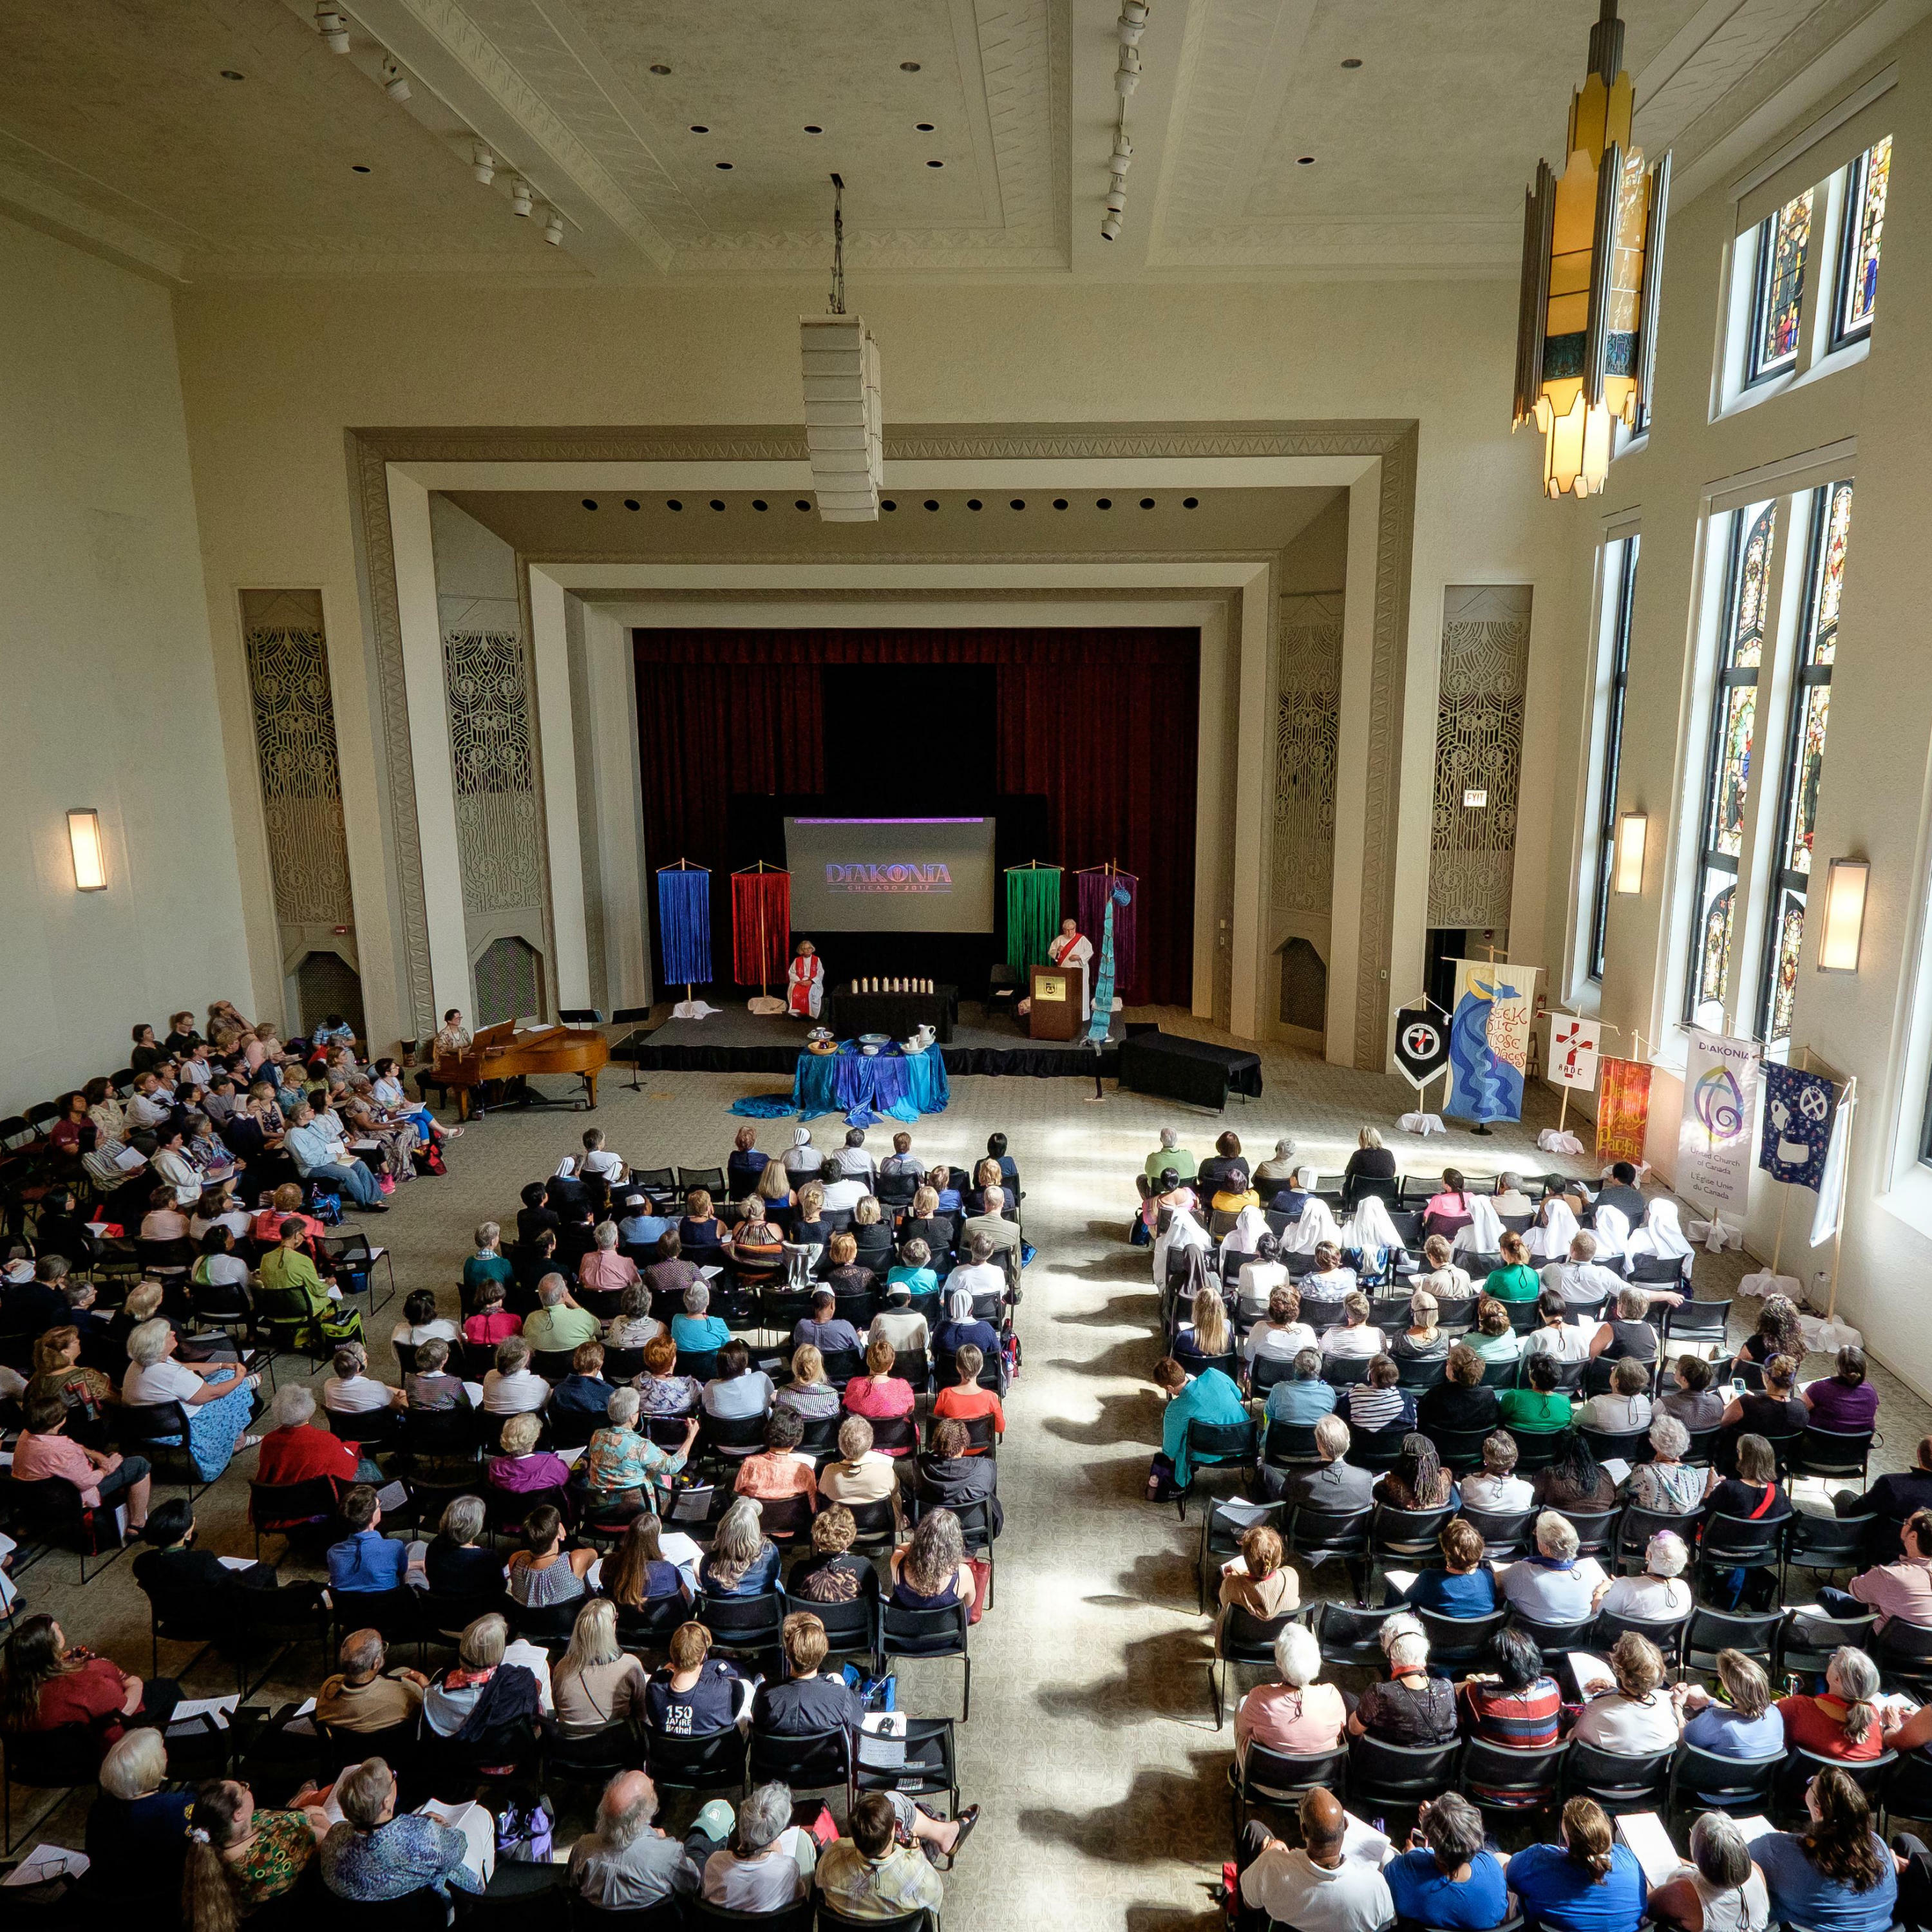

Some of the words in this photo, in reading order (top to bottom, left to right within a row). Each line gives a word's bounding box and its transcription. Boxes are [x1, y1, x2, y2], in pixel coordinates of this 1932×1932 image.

[1699, 1041, 1749, 1060] DIAKONIA
[1558, 1064, 1582, 1075] AADC
[1714, 1155, 1740, 1166] Church
[1705, 1162, 1731, 1175] Canada
[1703, 1186, 1729, 1199] Canada
[666, 1705, 694, 1719] 150
